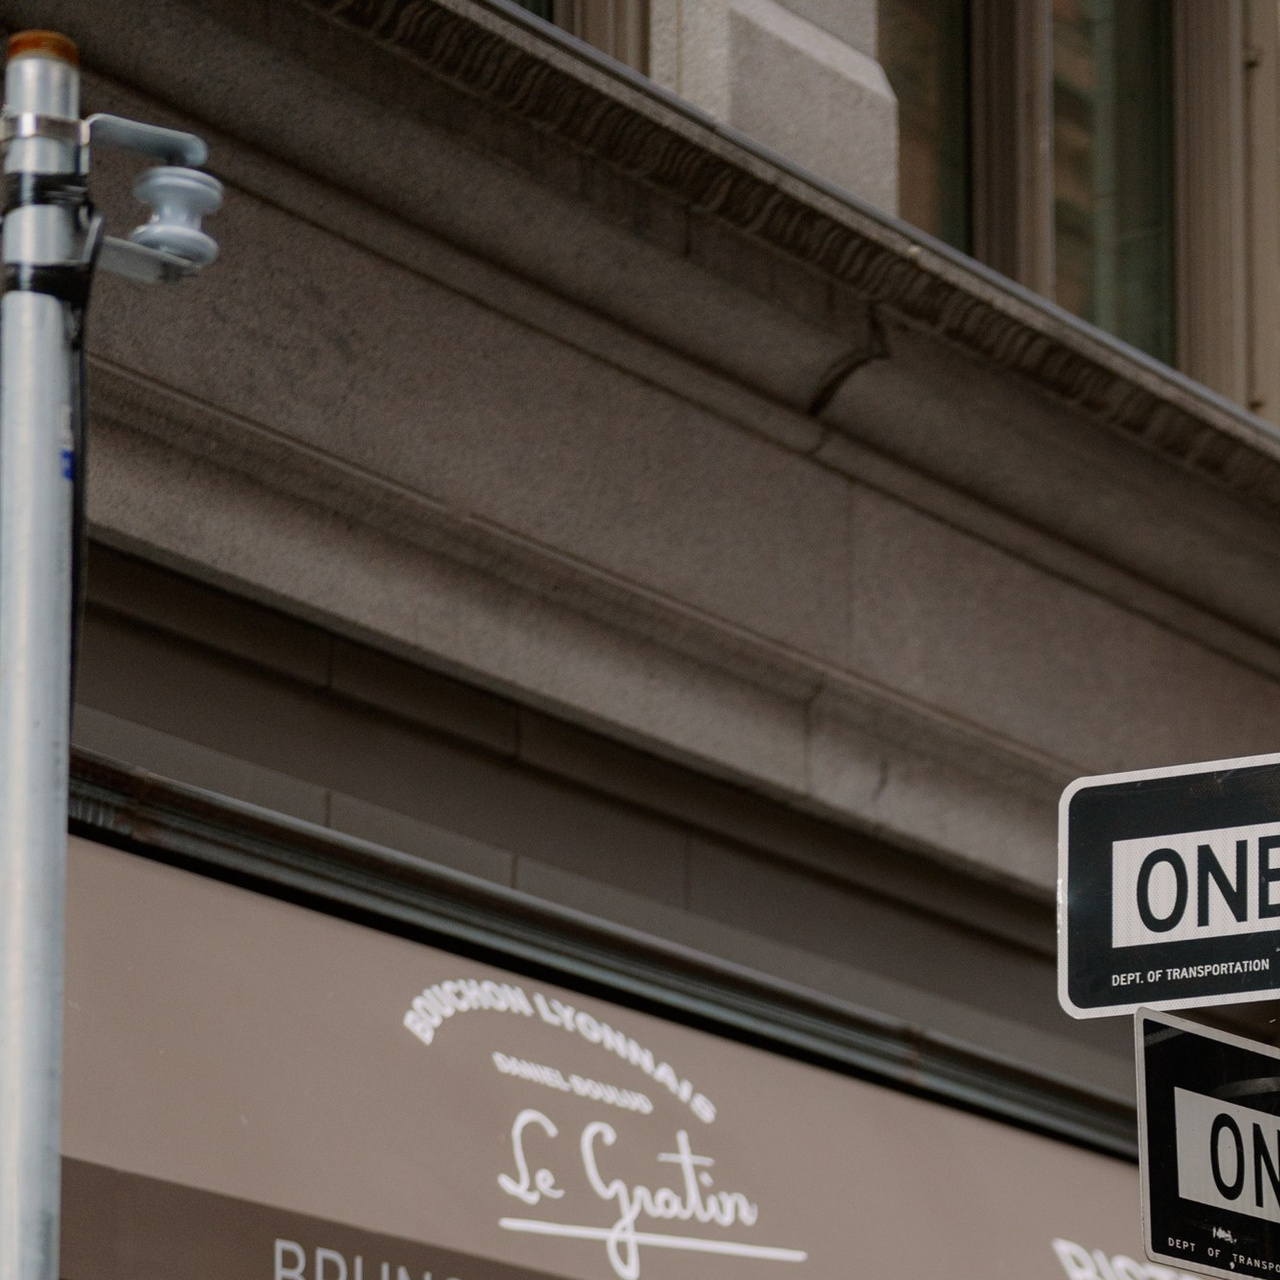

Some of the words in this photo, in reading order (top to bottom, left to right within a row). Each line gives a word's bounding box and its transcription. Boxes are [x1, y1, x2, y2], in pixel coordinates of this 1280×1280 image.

[1111, 972, 1144, 987] DEPT.
[1147, 969, 1164, 983] OF
[1166, 958, 1270, 981] TRANSPORTATION
[403, 979, 533, 1046] BOUCHON
[498, 1108, 565, 1205] Le
[1168, 1237, 1196, 1251] DEPT
[1207, 1248, 1221, 1258] OF
